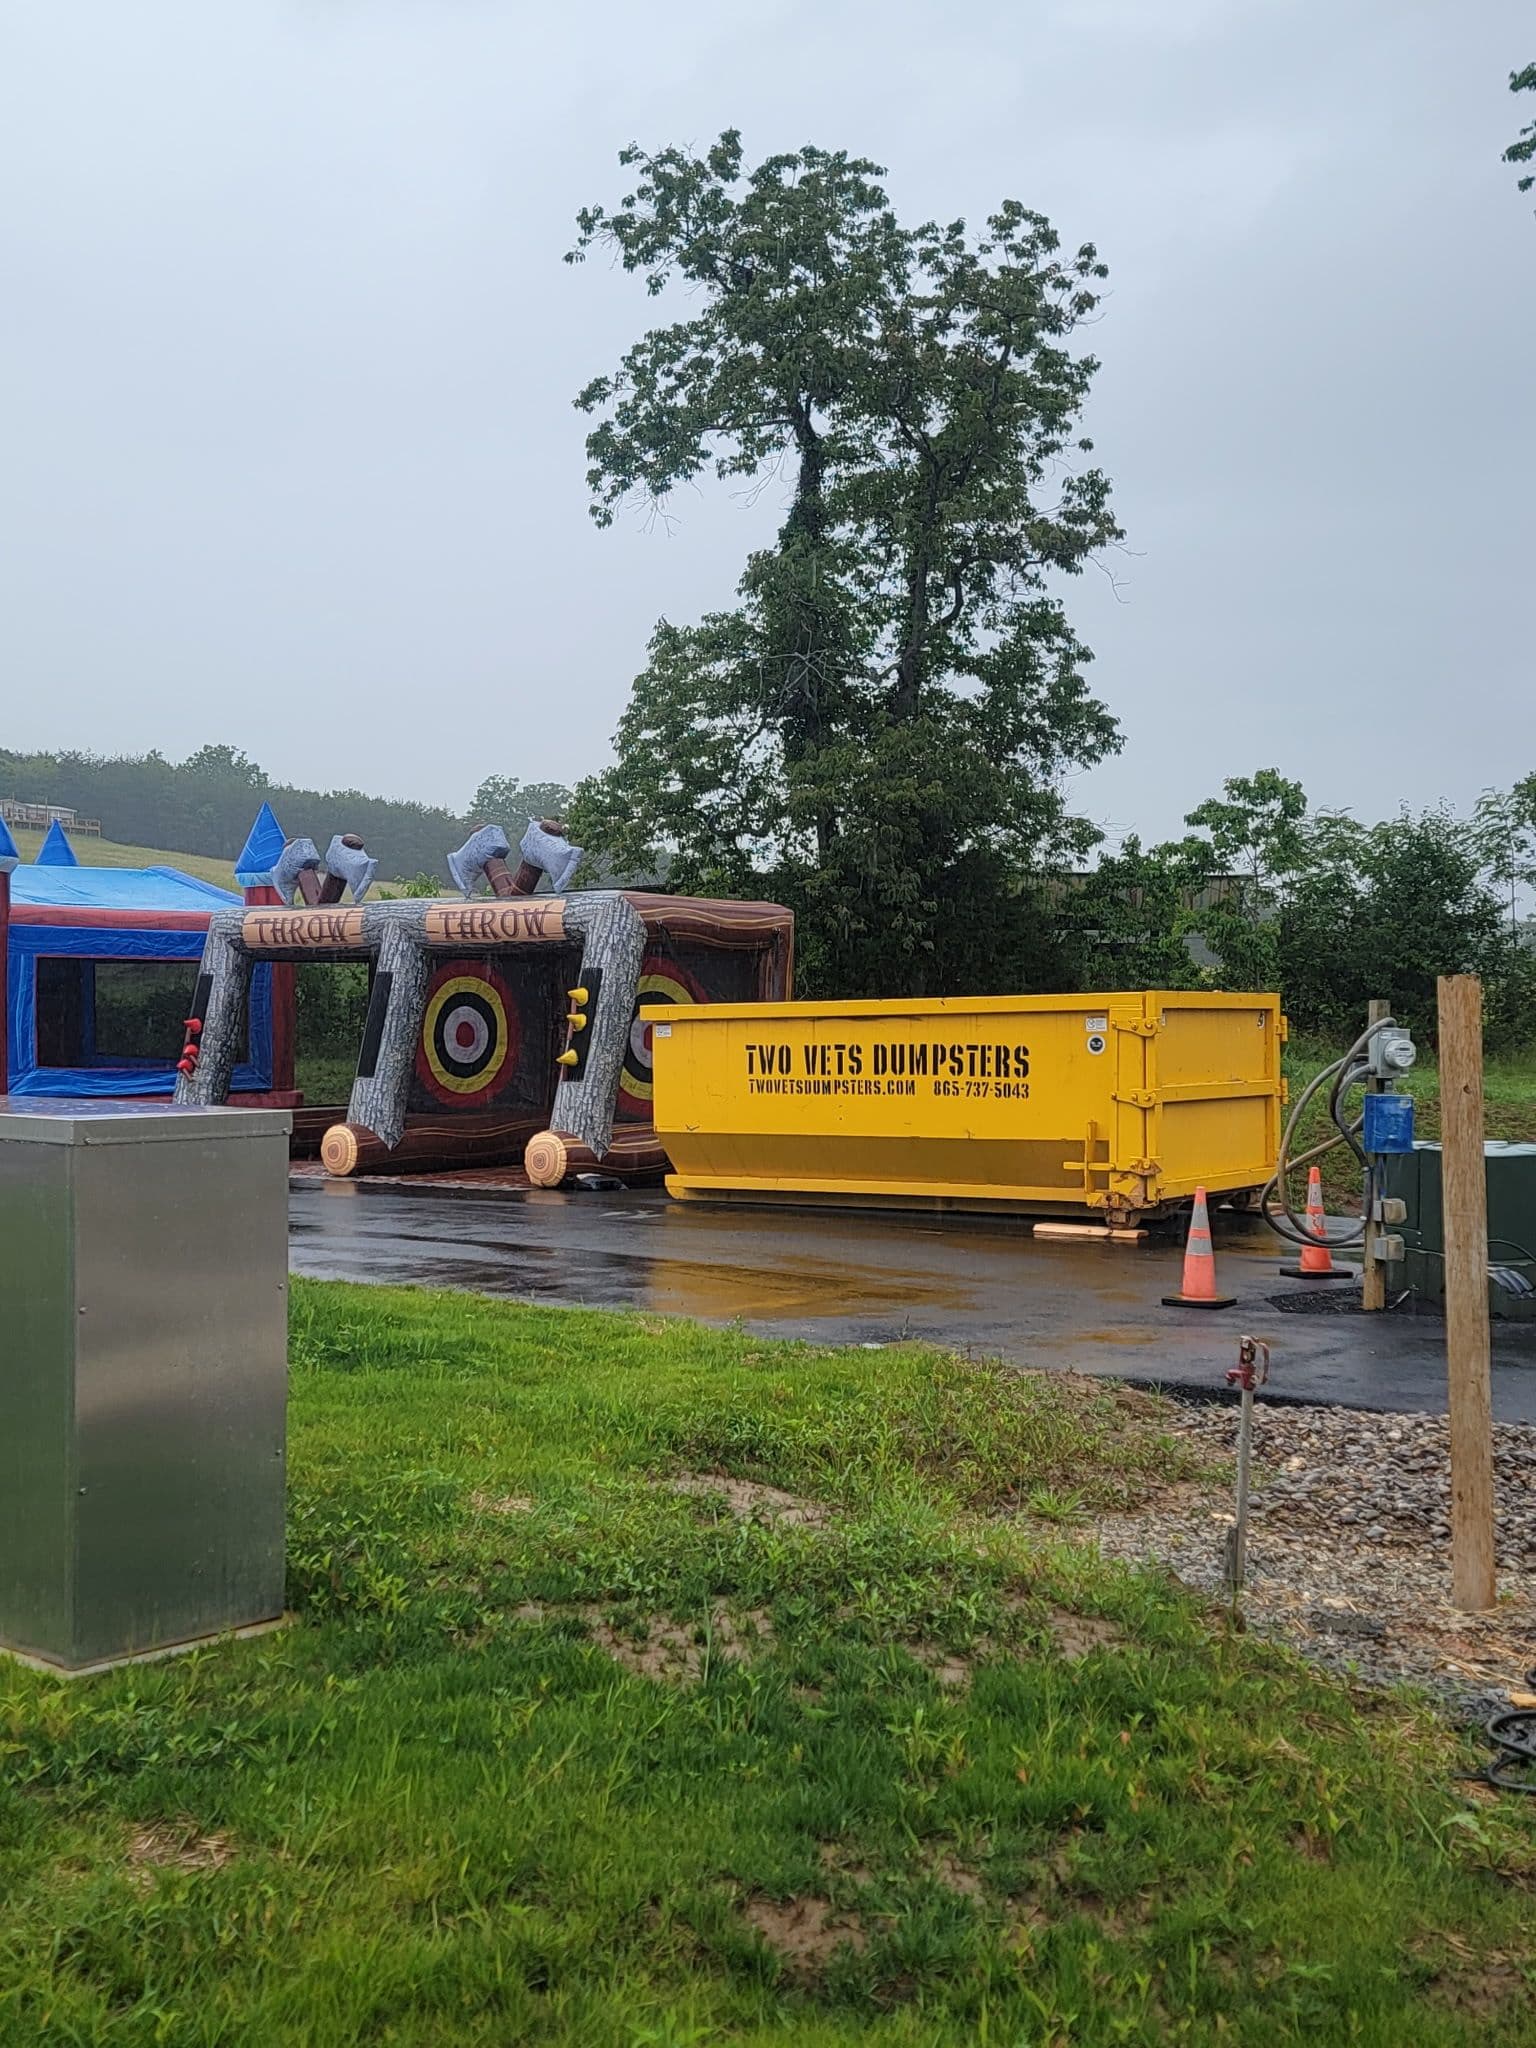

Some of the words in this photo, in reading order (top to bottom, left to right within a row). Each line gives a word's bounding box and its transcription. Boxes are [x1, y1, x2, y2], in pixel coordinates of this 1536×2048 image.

[254, 913, 349, 945] THROW
[439, 904, 550, 940] THROW
[745, 1044, 791, 1076] TWO
[804, 1044, 862, 1076] VETS
[873, 1044, 1029, 1079] DUMPSTERS
[749, 1079, 916, 1096] TWOVETSDUMPSTERS.COM
[933, 1081, 1030, 1099] 865-737-5043
